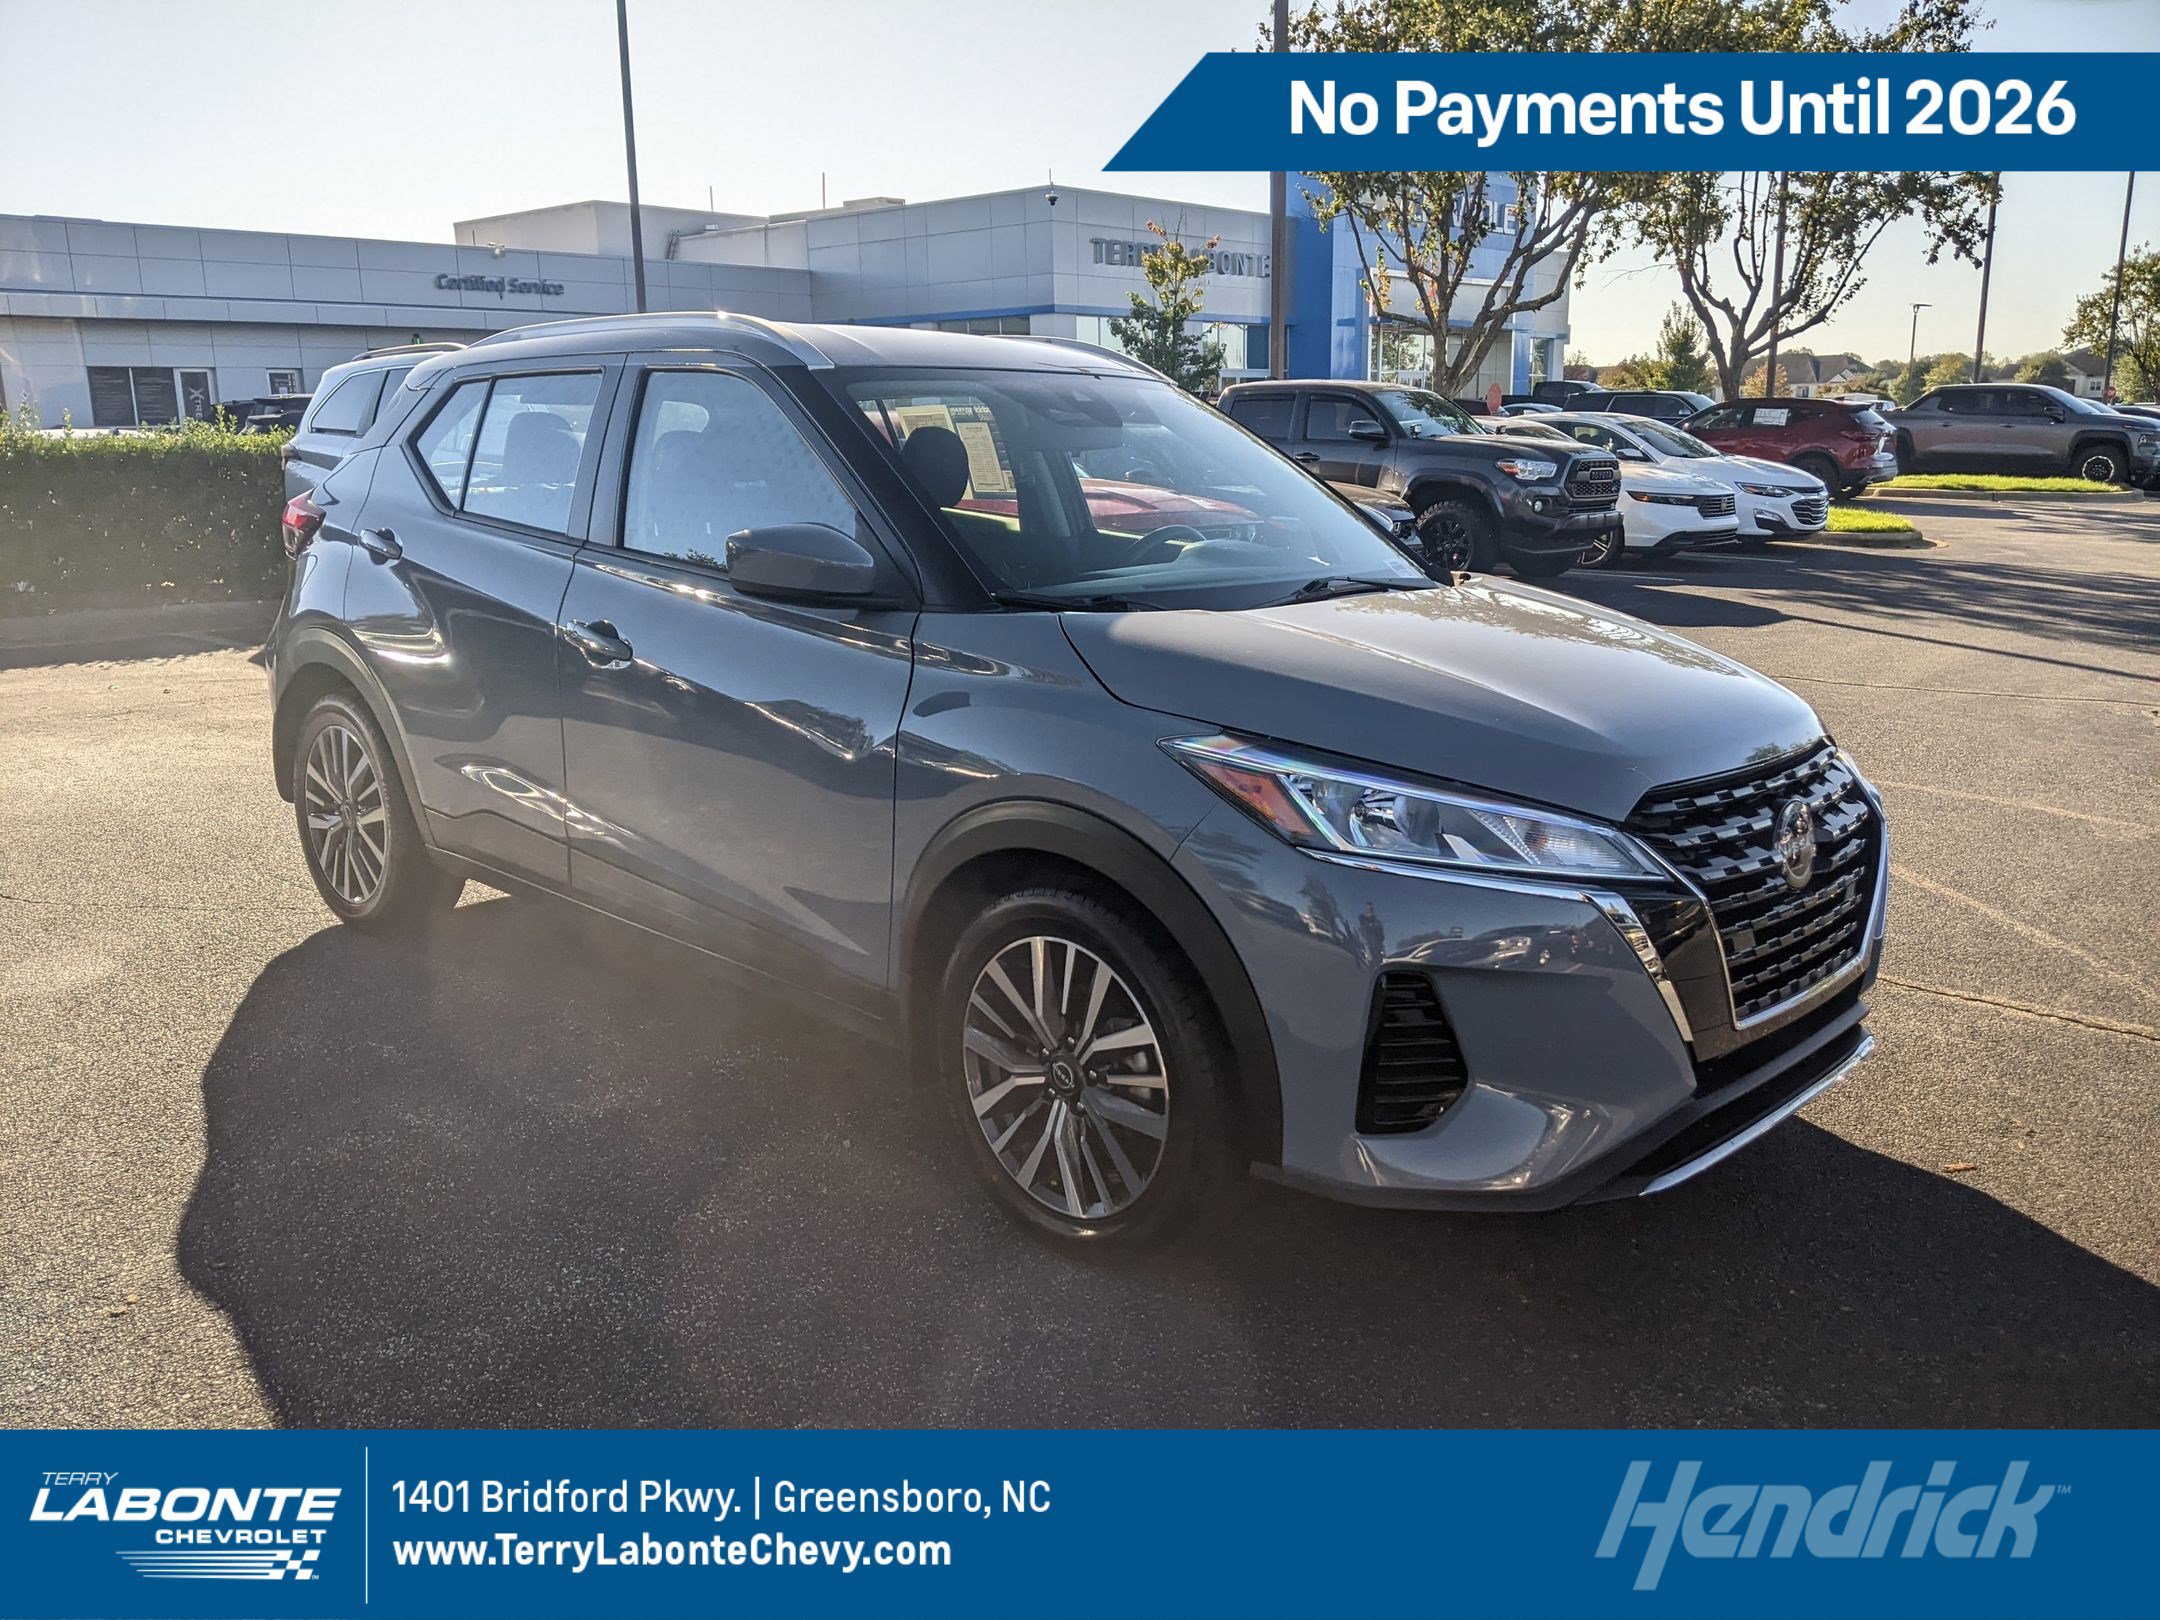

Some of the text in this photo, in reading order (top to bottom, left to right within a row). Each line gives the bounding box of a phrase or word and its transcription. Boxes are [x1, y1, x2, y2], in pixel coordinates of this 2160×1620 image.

[1090, 237, 1271, 278] TERR BONTE
[508, 277, 565, 296] Service
[188, 387, 205, 419] XTRE
